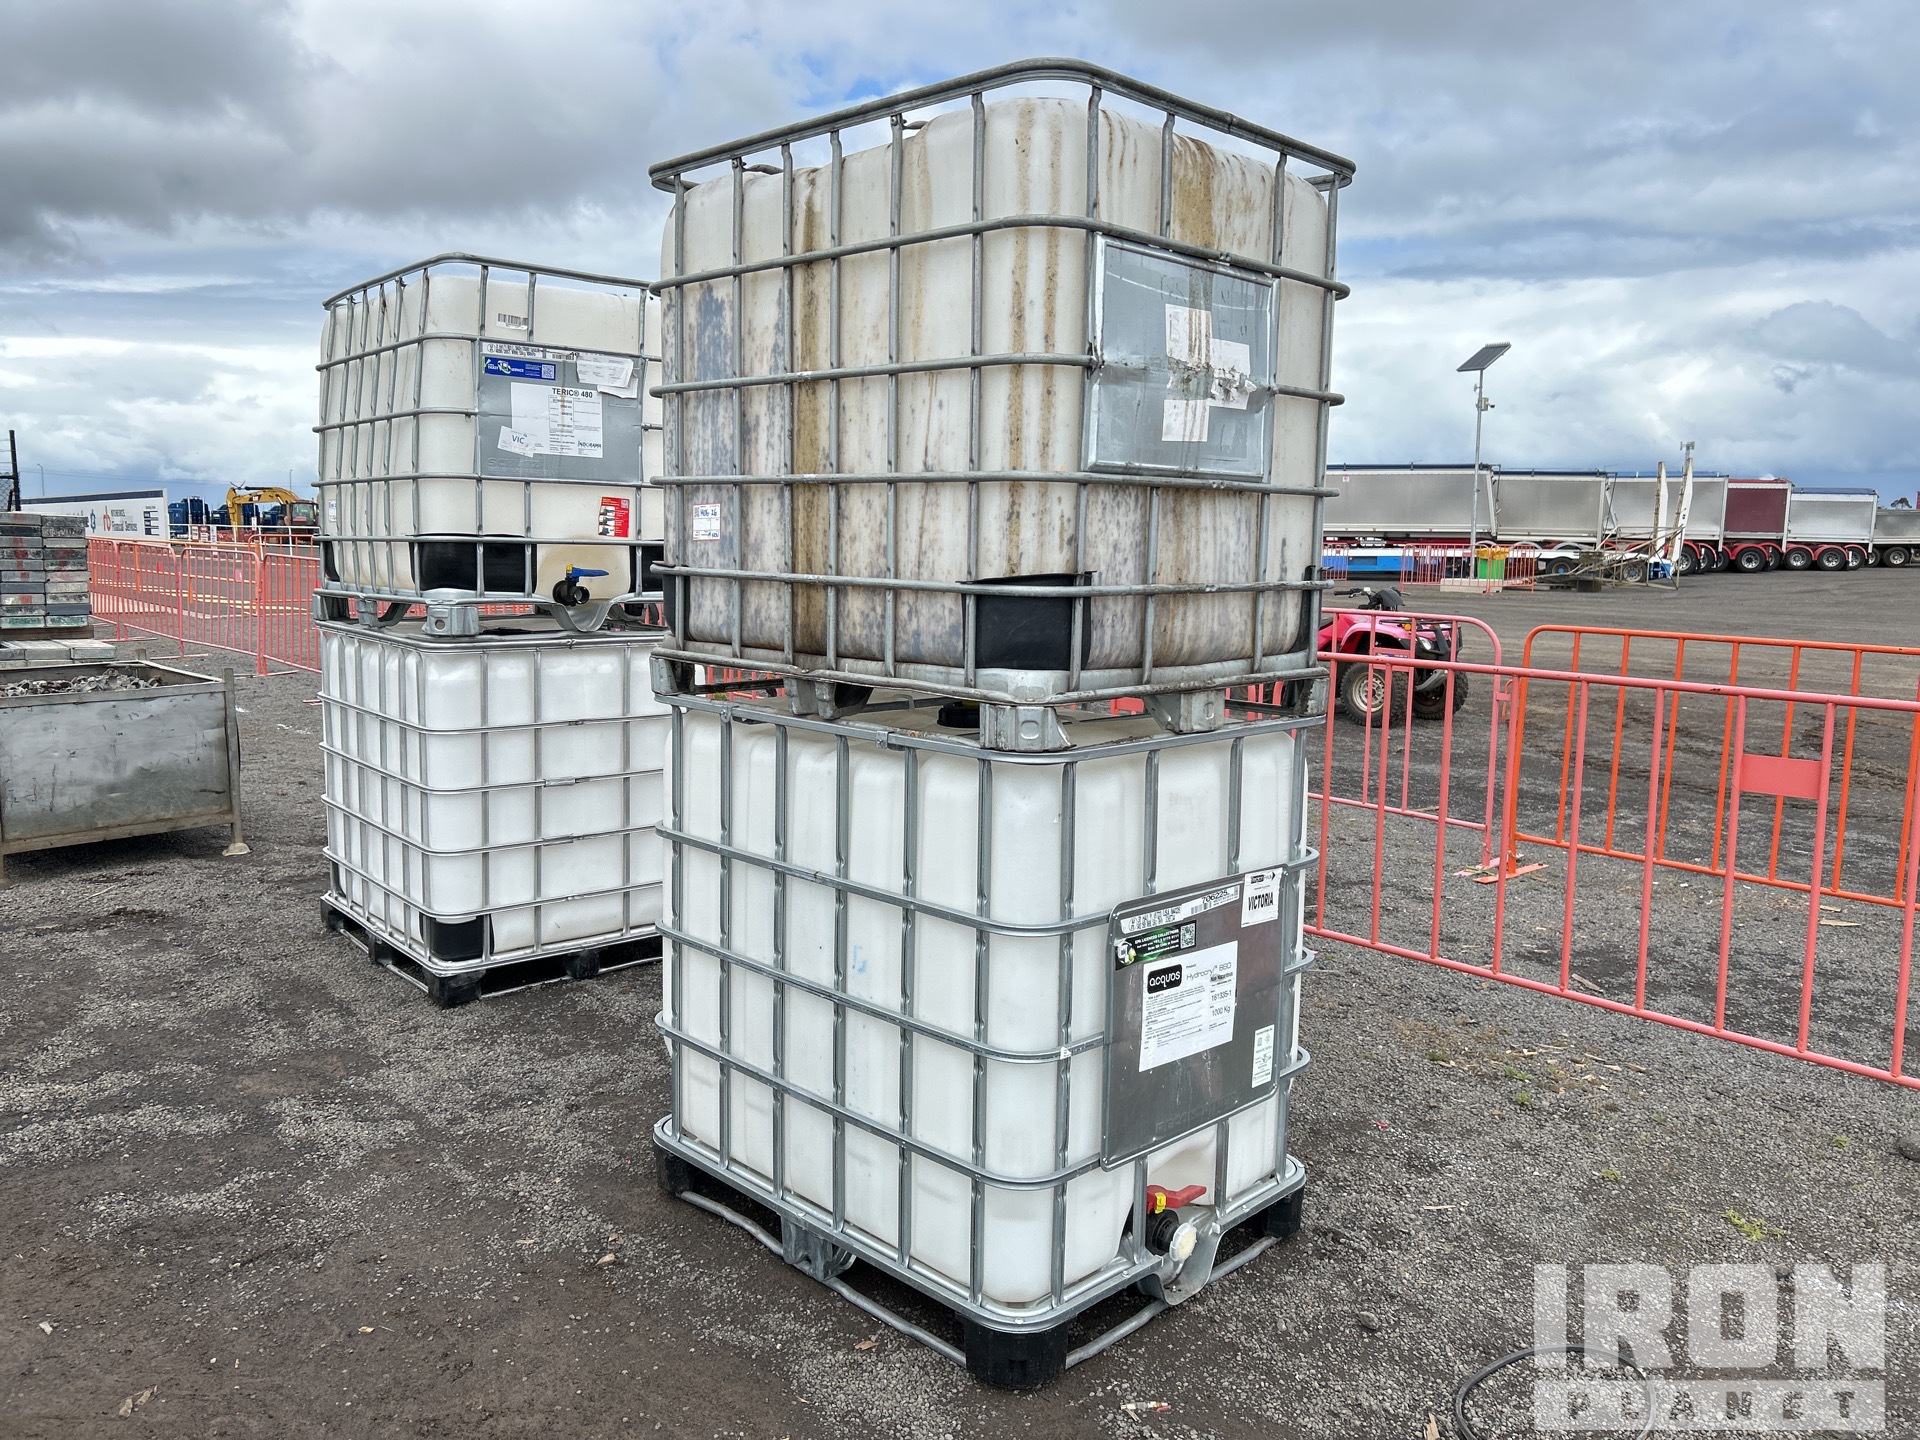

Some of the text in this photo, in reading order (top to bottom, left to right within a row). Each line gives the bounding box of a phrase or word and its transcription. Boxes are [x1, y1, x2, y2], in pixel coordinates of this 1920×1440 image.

[512, 434, 525, 445] VIC
[1248, 892, 1274, 911] VICTORIA
[1149, 970, 1181, 988] acquos
